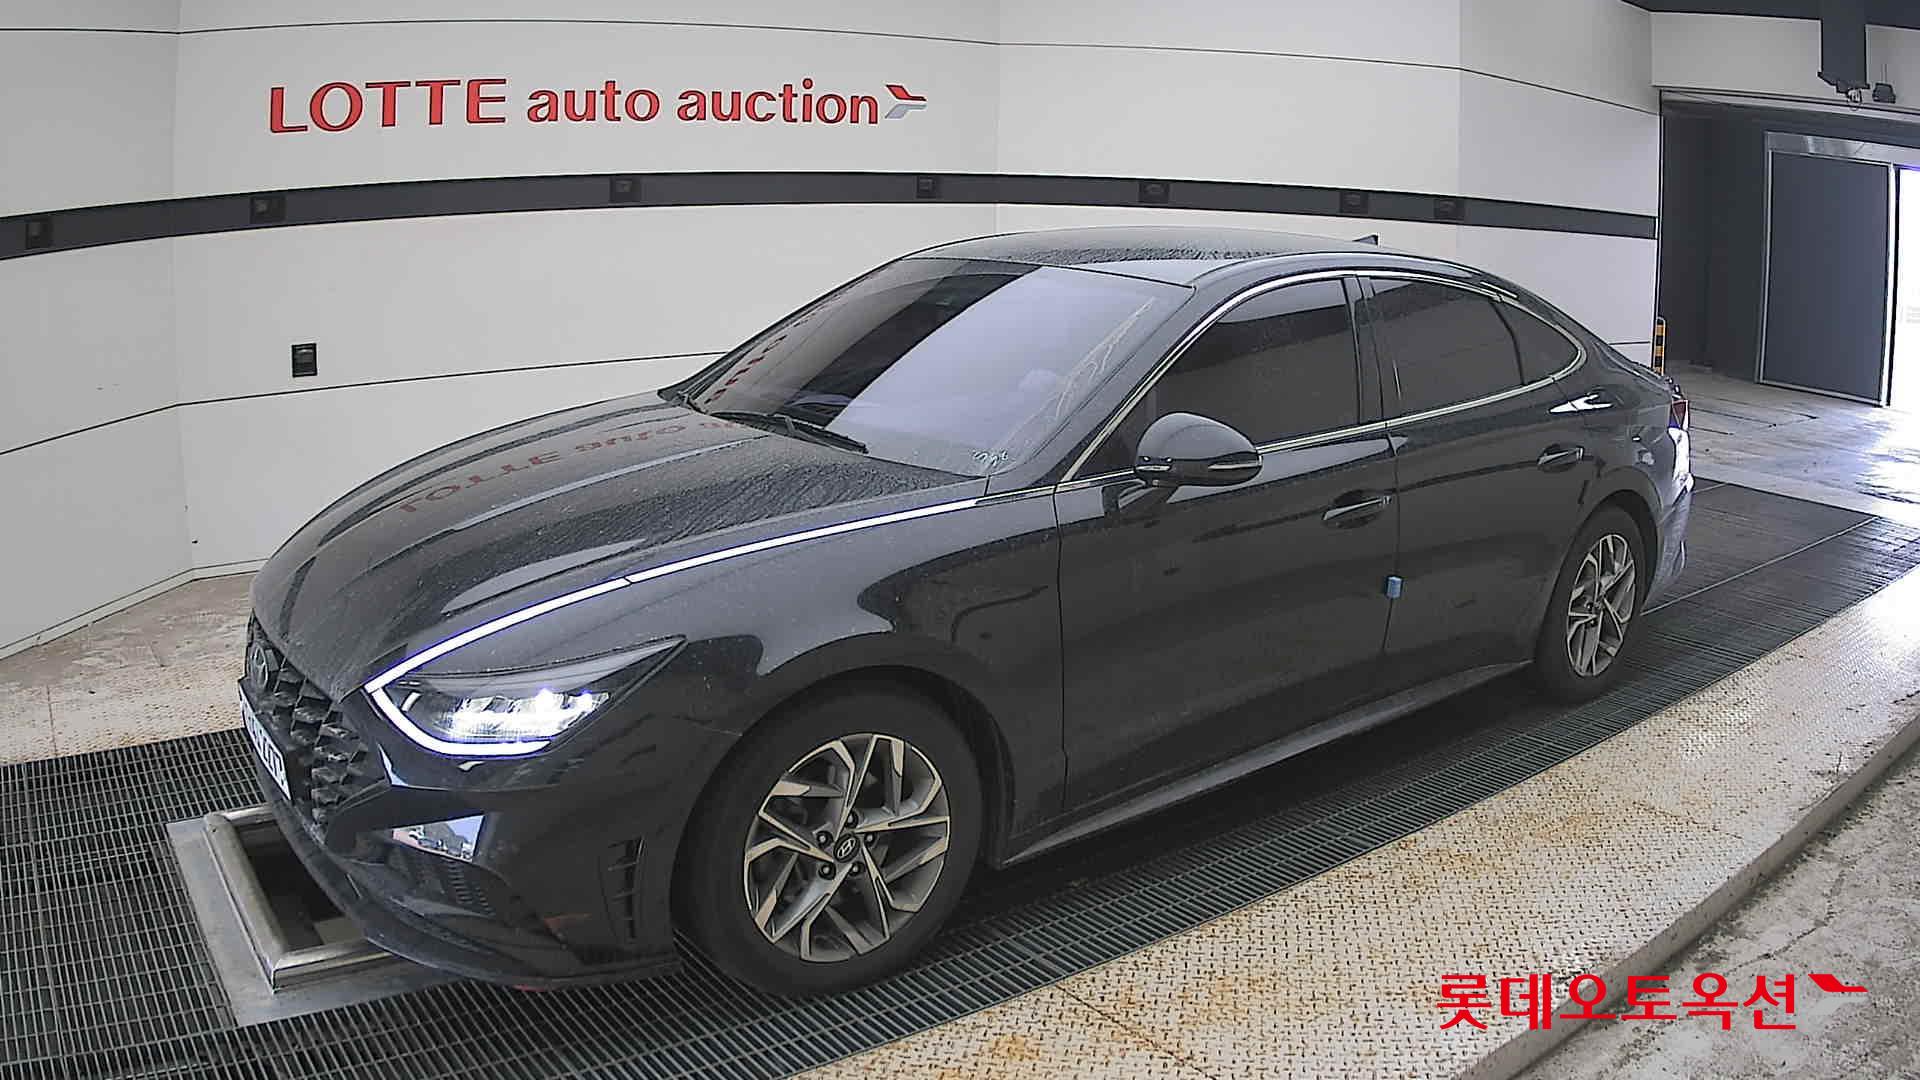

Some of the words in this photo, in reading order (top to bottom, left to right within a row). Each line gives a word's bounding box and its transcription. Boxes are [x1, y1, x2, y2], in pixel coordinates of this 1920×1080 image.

[270, 79, 506, 134] LOTTE
[528, 81, 661, 123] auto
[676, 79, 879, 124] auction
